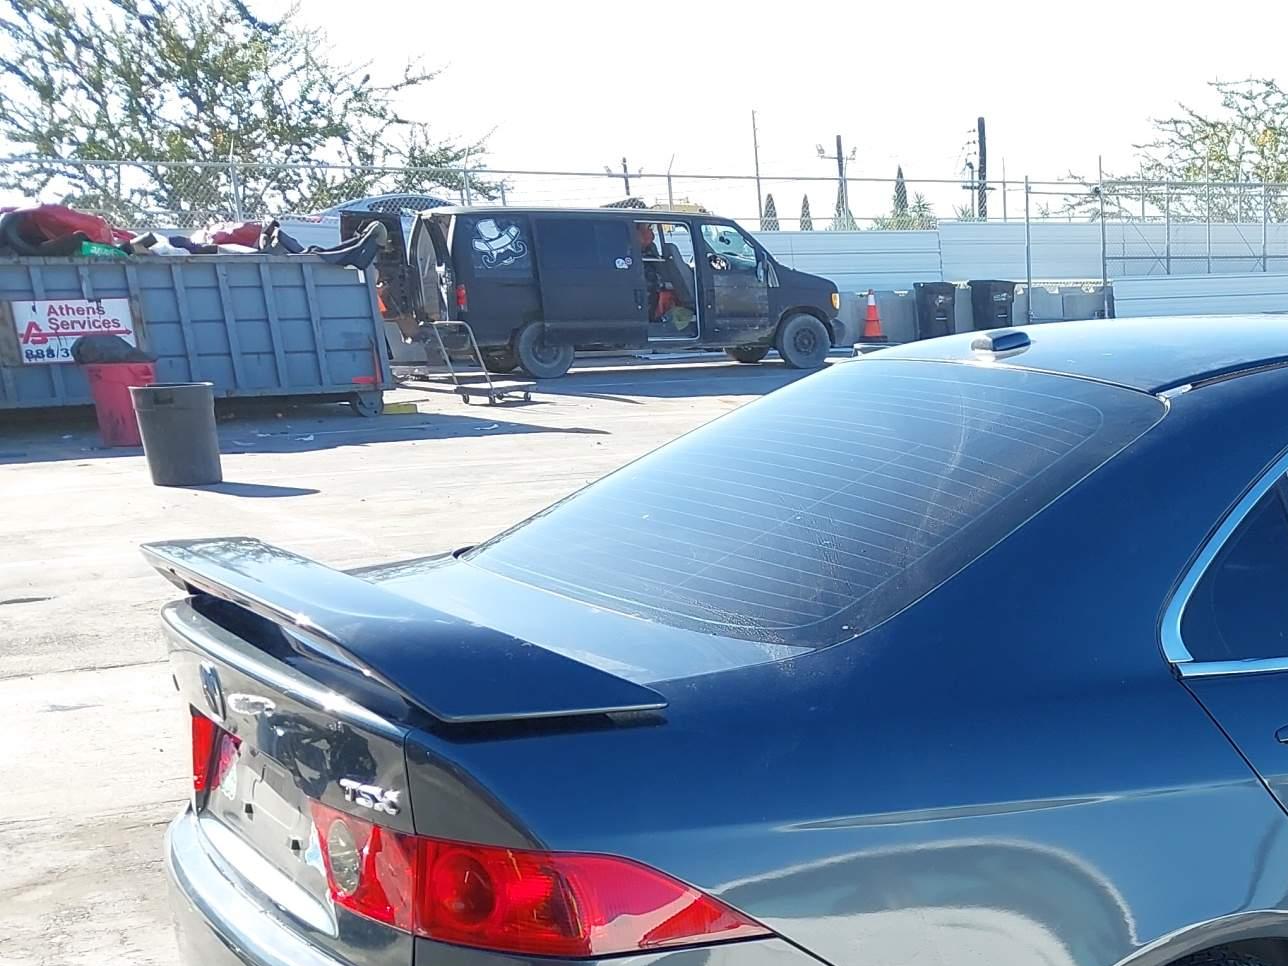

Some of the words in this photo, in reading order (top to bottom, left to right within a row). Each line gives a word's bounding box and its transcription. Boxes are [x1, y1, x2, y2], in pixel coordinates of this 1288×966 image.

[47, 303, 106, 317] Athens
[48, 317, 121, 331] Services
[338, 777, 401, 816] TSX
